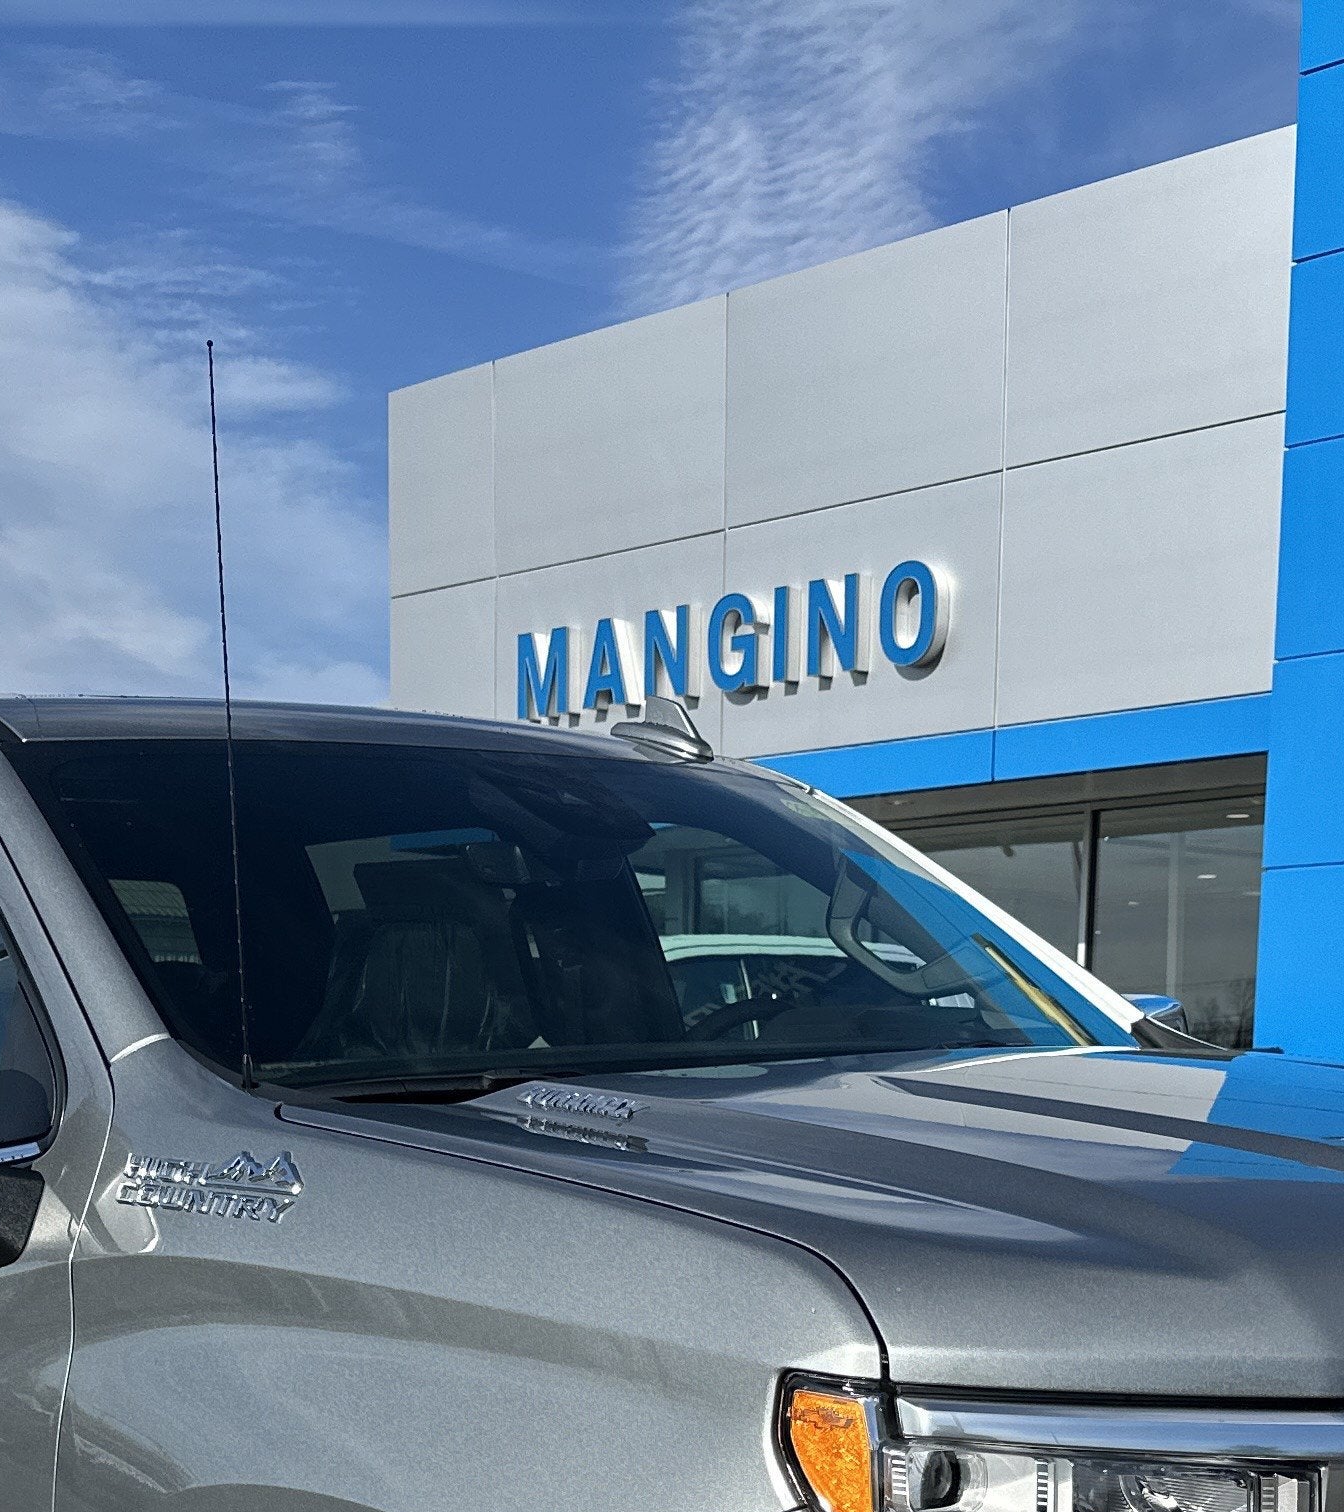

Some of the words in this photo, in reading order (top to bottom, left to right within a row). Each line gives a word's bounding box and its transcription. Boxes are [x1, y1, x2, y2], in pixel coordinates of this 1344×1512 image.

[517, 559, 946, 720] MANGINO
[124, 1152, 209, 1185] HIGH
[116, 1182, 296, 1224] COUNTRY
